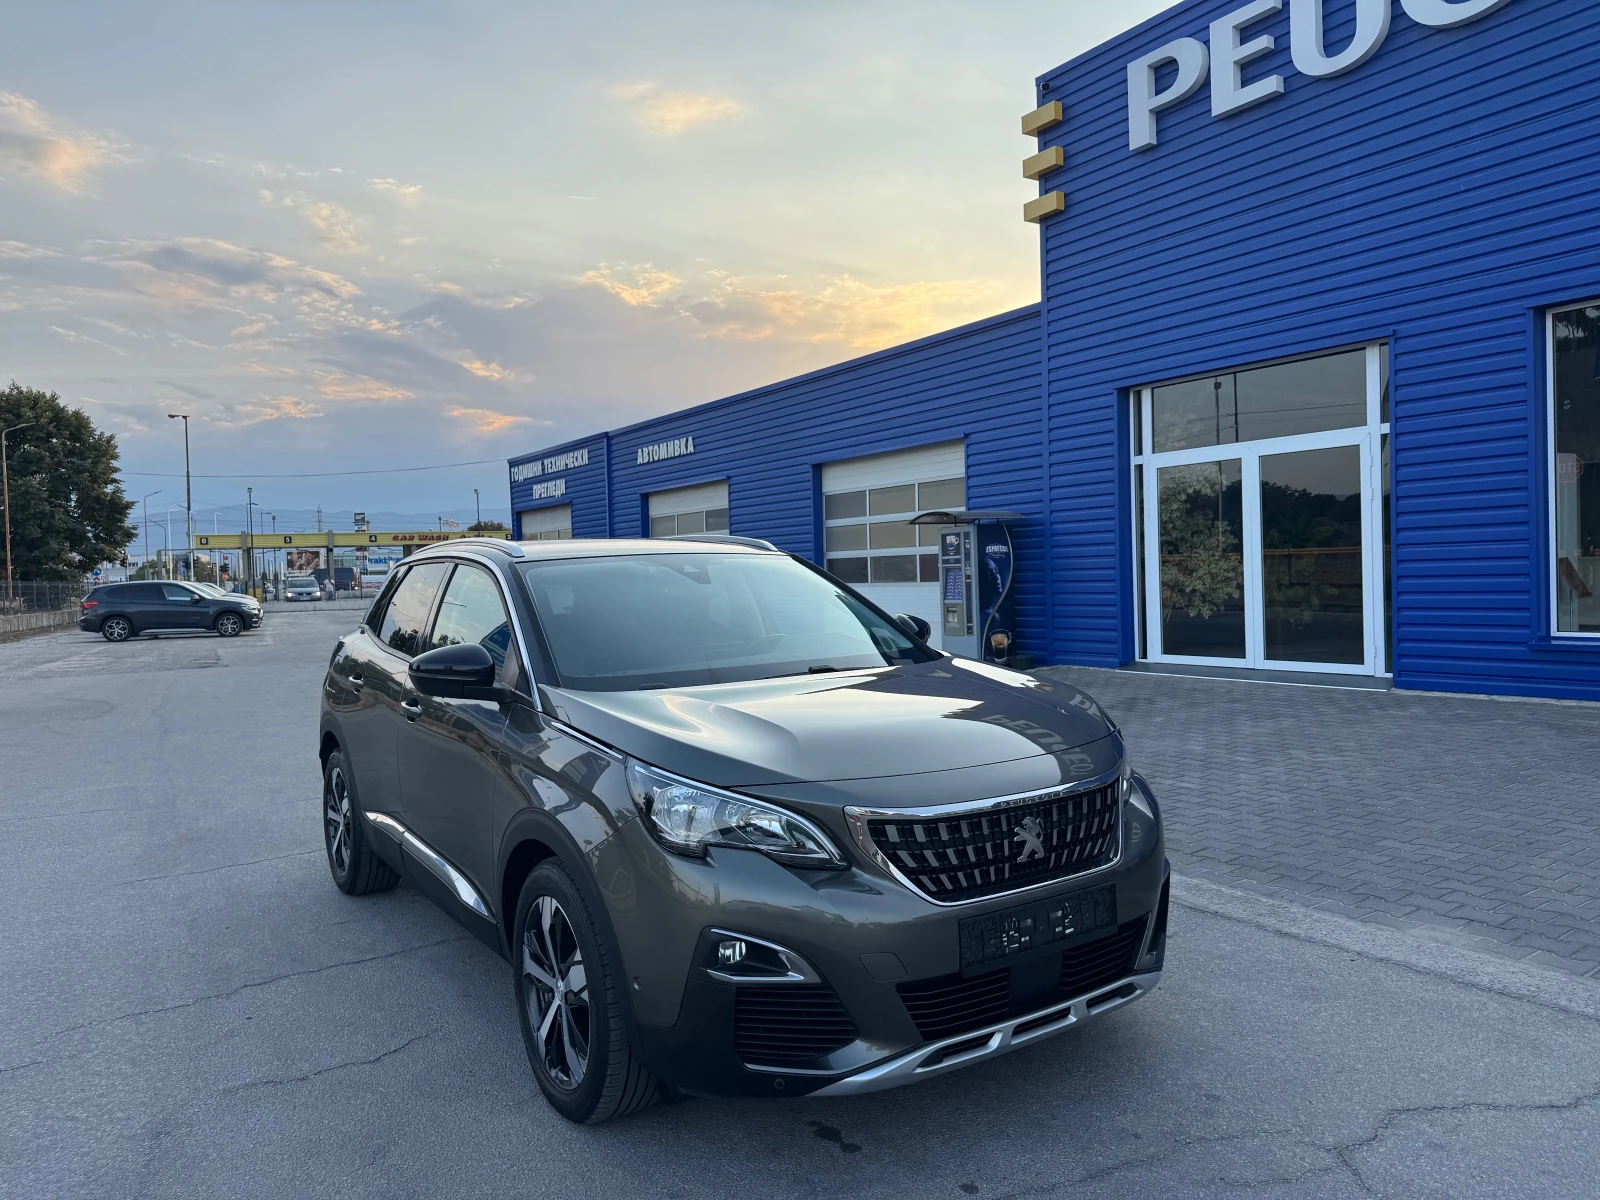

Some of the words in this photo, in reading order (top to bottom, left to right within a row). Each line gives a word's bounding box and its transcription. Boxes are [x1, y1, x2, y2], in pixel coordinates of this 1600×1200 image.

[637, 436, 695, 465] АВТОМИВКА
[510, 460, 543, 483] ГОДИШНИ
[543, 448, 589, 474] ТЕХНИЧЕСКИ
[532, 478, 566, 500] ПРЕГЛЕДИ
